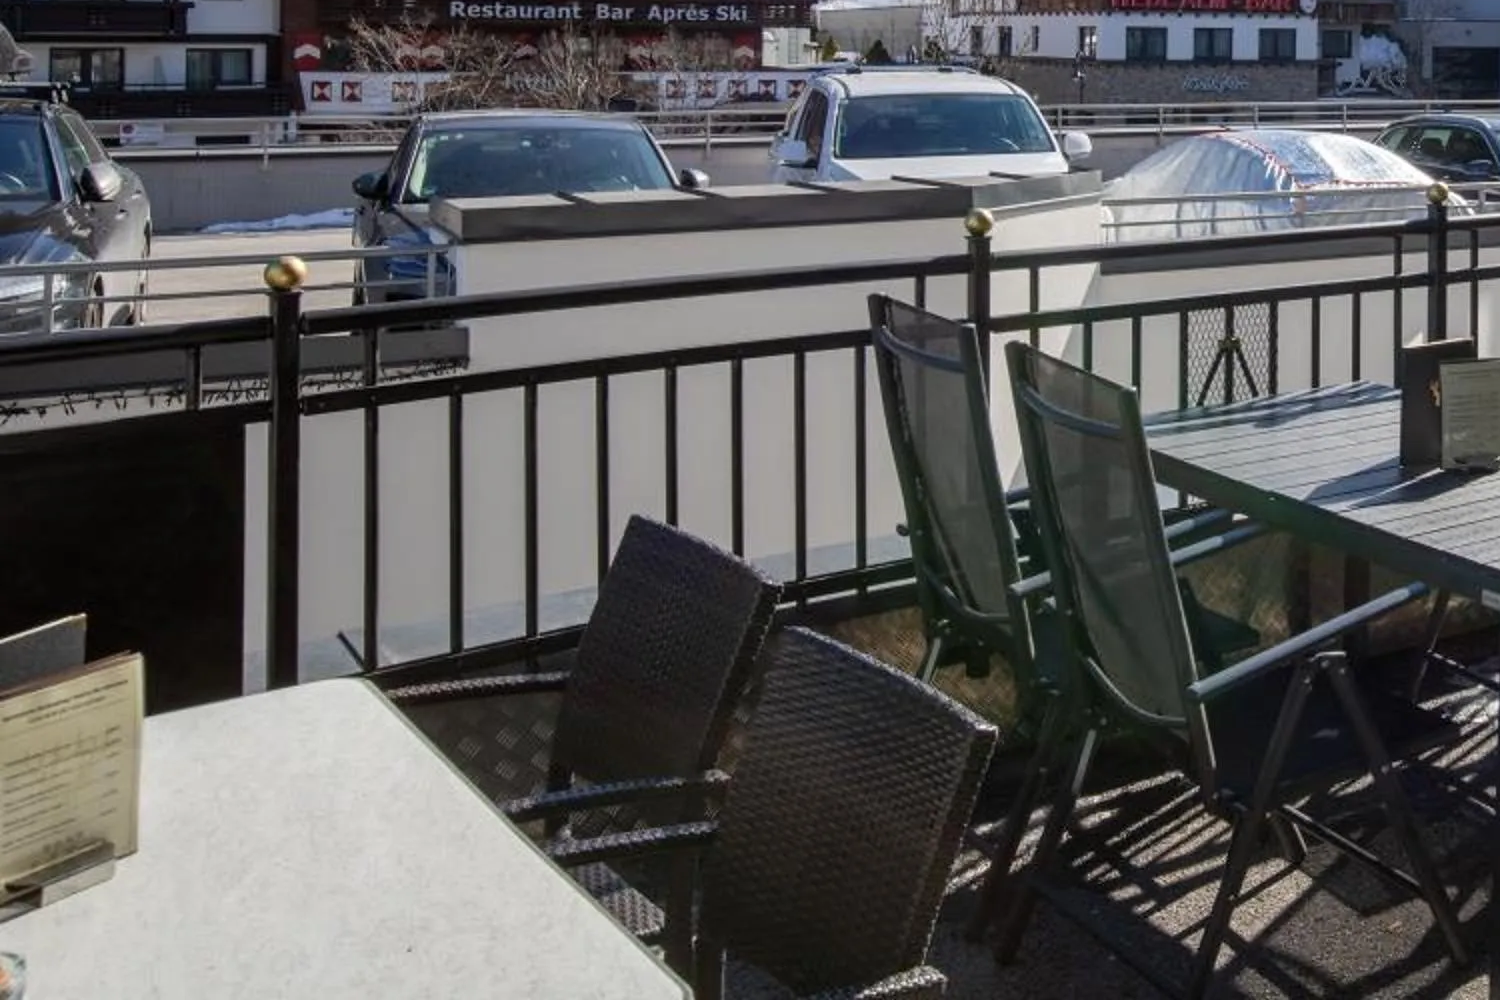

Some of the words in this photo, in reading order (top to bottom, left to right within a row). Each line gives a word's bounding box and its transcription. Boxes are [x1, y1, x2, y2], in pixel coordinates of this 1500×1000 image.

[450, 1, 582, 19] Restaurant
[596, 3, 634, 20] Bar
[715, 5, 749, 21] Ski
